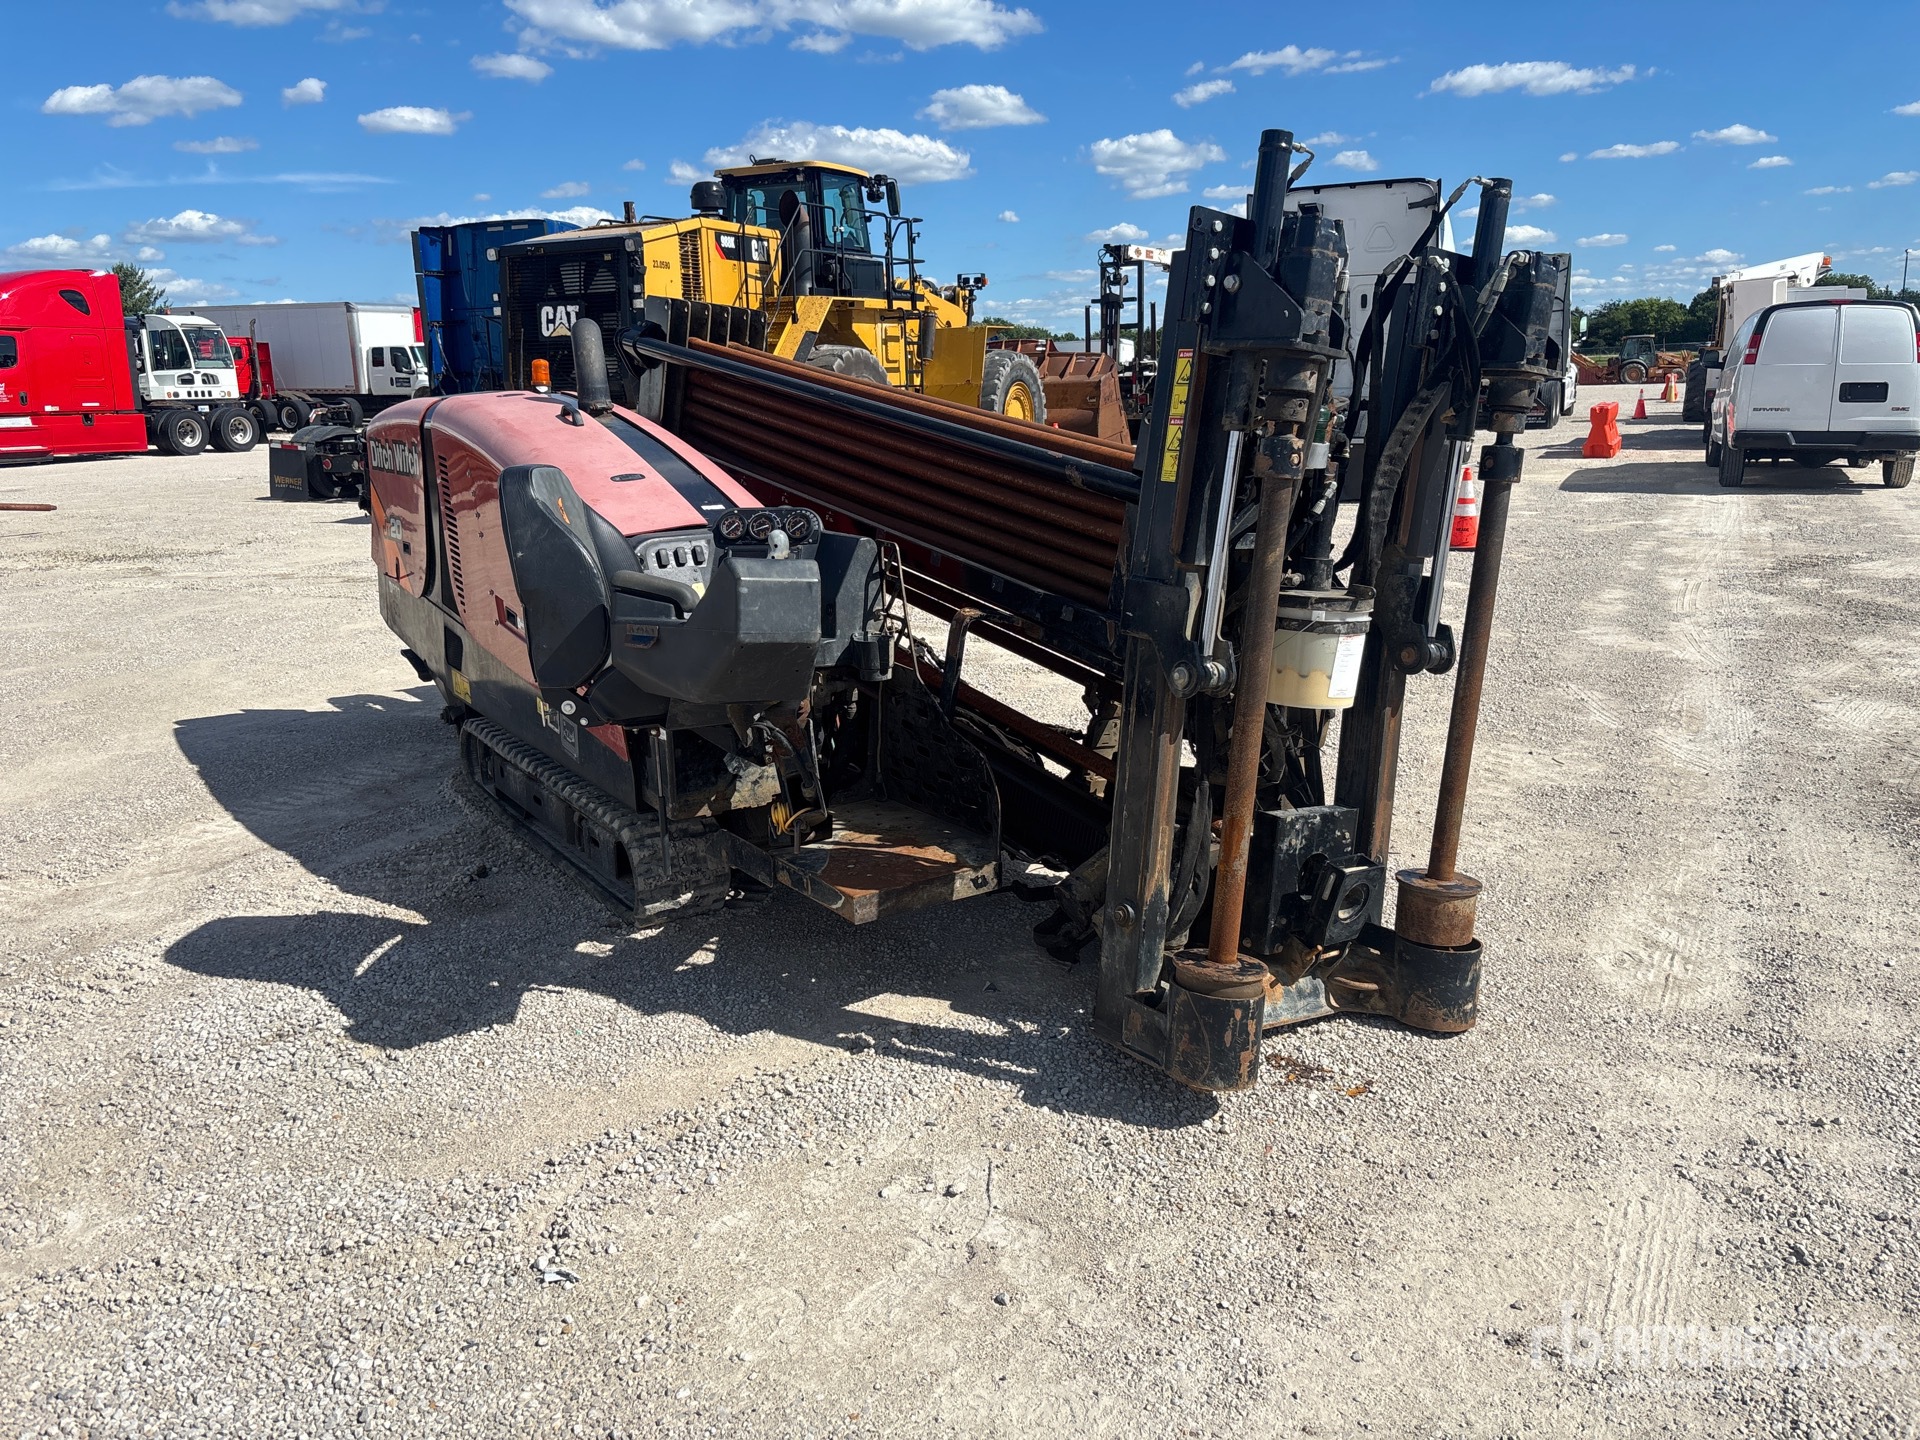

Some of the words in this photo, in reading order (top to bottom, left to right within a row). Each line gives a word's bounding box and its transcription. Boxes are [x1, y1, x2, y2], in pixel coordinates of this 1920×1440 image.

[720, 235, 736, 249] 988K
[751, 239, 768, 261] CAT
[541, 305, 579, 337] CAT
[369, 440, 395, 470] Ditch
[393, 443, 419, 475] Witch
[273, 474, 303, 486] WERNER
